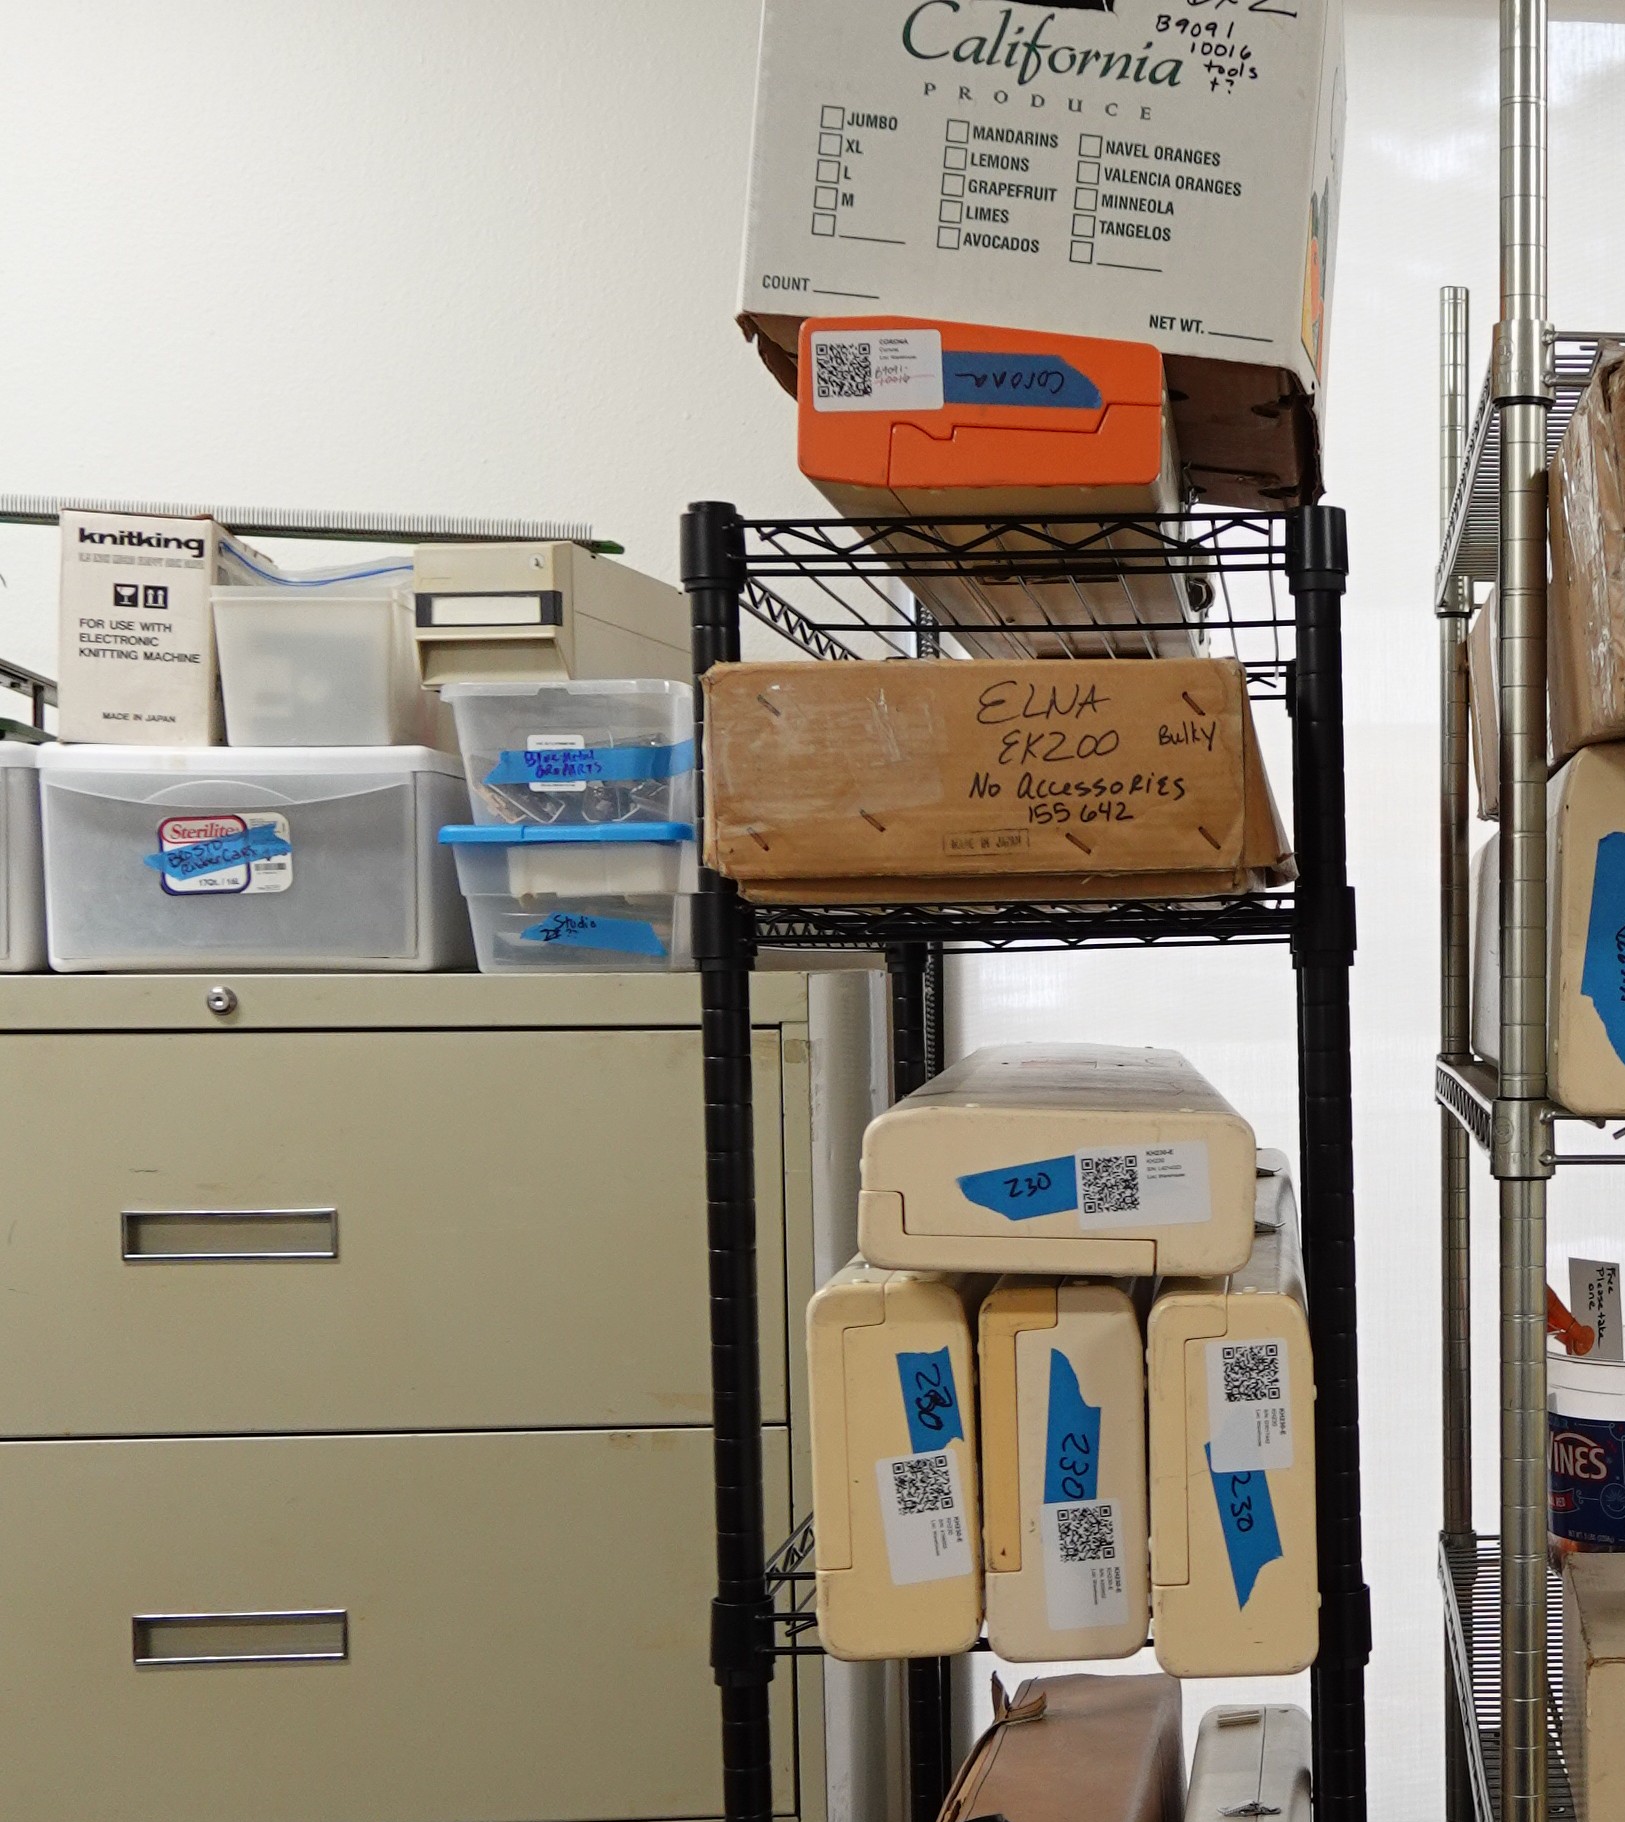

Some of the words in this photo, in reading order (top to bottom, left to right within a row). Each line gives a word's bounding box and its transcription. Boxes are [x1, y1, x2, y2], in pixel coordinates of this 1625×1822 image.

[1156, 14, 1234, 38] B9091
[902, 0, 1184, 86] California
[923, 82, 1152, 120] PRODUCE
[847, 112, 898, 131] JUMBO
[845, 138, 865, 155] XL
[972, 125, 1059, 148] MANDARINS
[970, 152, 1031, 172] LEMONS
[1105, 140, 1150, 159] NAVEL
[1154, 145, 1221, 167] ORANGES
[844, 166, 852, 180] L
[1104, 167, 1172, 188] VALENCIA
[1175, 175, 1243, 197] ORANGES
[841, 193, 854, 208] M
[968, 179, 1058, 202] GRAPEFRUIT
[965, 205, 1010, 224] LIMES
[1101, 193, 1175, 216] MINNEOLA
[1099, 219, 1172, 242] TANGELOS
[962, 232, 1040, 253] AVOCADOS
[762, 274, 810, 292] COUNT
[1149, 314, 1176, 330] NET
[1180, 318, 1205, 334] WT.
[79, 527, 205, 558] knitking
[79, 618, 105, 629] FOR
[109, 619, 135, 631] USE
[139, 621, 172, 633] WITH
[79, 633, 160, 647] ELECTRONIC
[79, 647, 139, 661] KNITTING
[143, 650, 201, 664] MACHINE
[977, 680, 1111, 725] ELNA
[103, 712, 129, 721] MADE
[133, 713, 143, 721] IN
[145, 714, 176, 723] JAPAN
[998, 729, 1121, 765] EK200
[1158, 721, 1216, 752] Bulky
[969, 772, 1001, 799] No
[170, 823, 235, 840] Sterilite
[553, 914, 597, 930] Studio
[1059, 1433, 1089, 1499] 230
